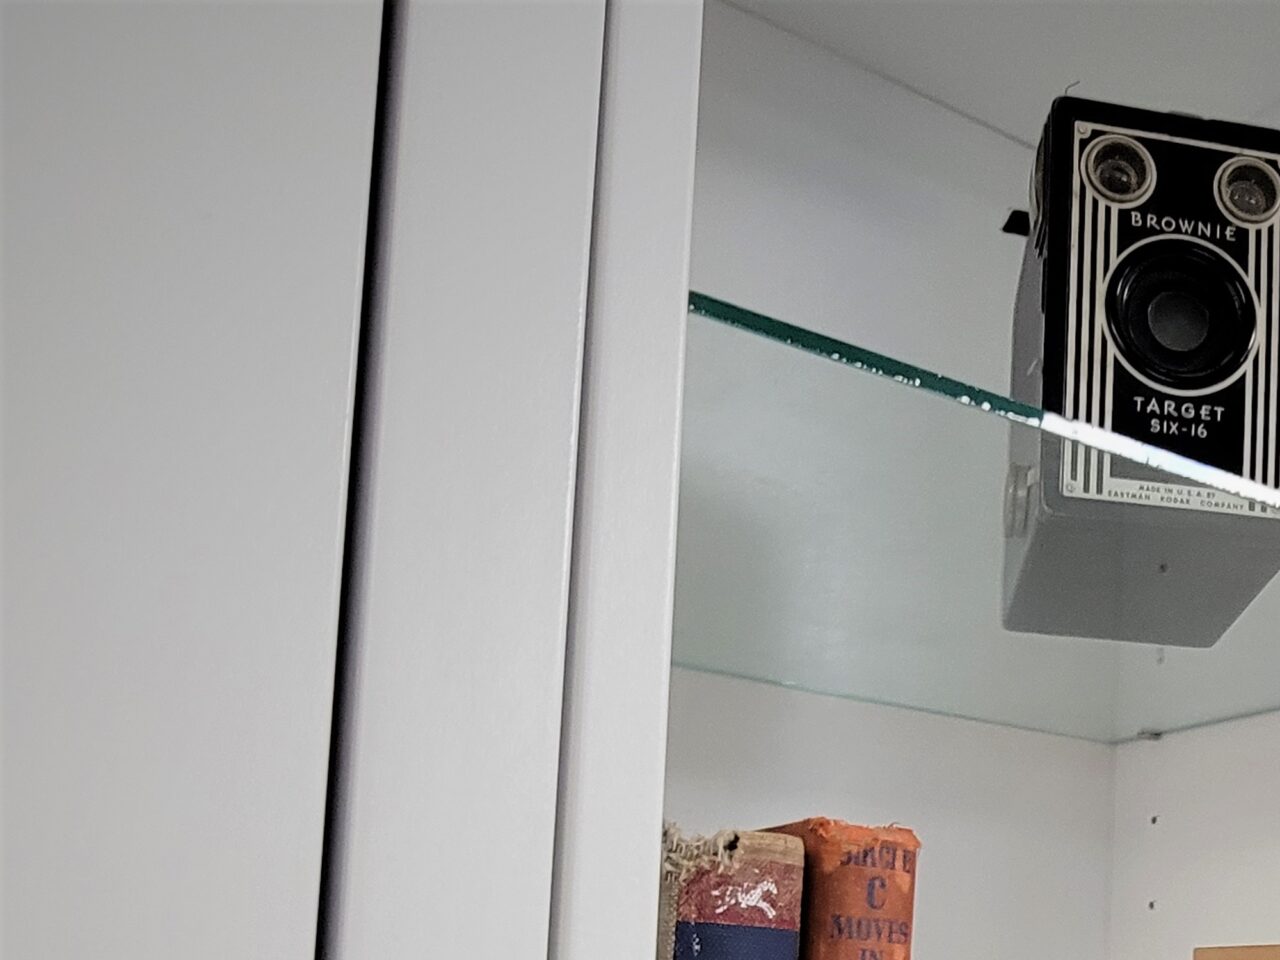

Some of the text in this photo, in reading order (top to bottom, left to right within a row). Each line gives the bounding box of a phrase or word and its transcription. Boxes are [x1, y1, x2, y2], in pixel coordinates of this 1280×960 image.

[1130, 211, 1238, 242] BROWNIE
[1133, 395, 1226, 423] TARGET
[1149, 418, 1209, 440] SIX-16
[1107, 489, 1151, 501] EASTMAN
[1160, 495, 1191, 506] KODAK
[1200, 500, 1244, 511] COMPANY
[1164, 487, 1174, 495] IN
